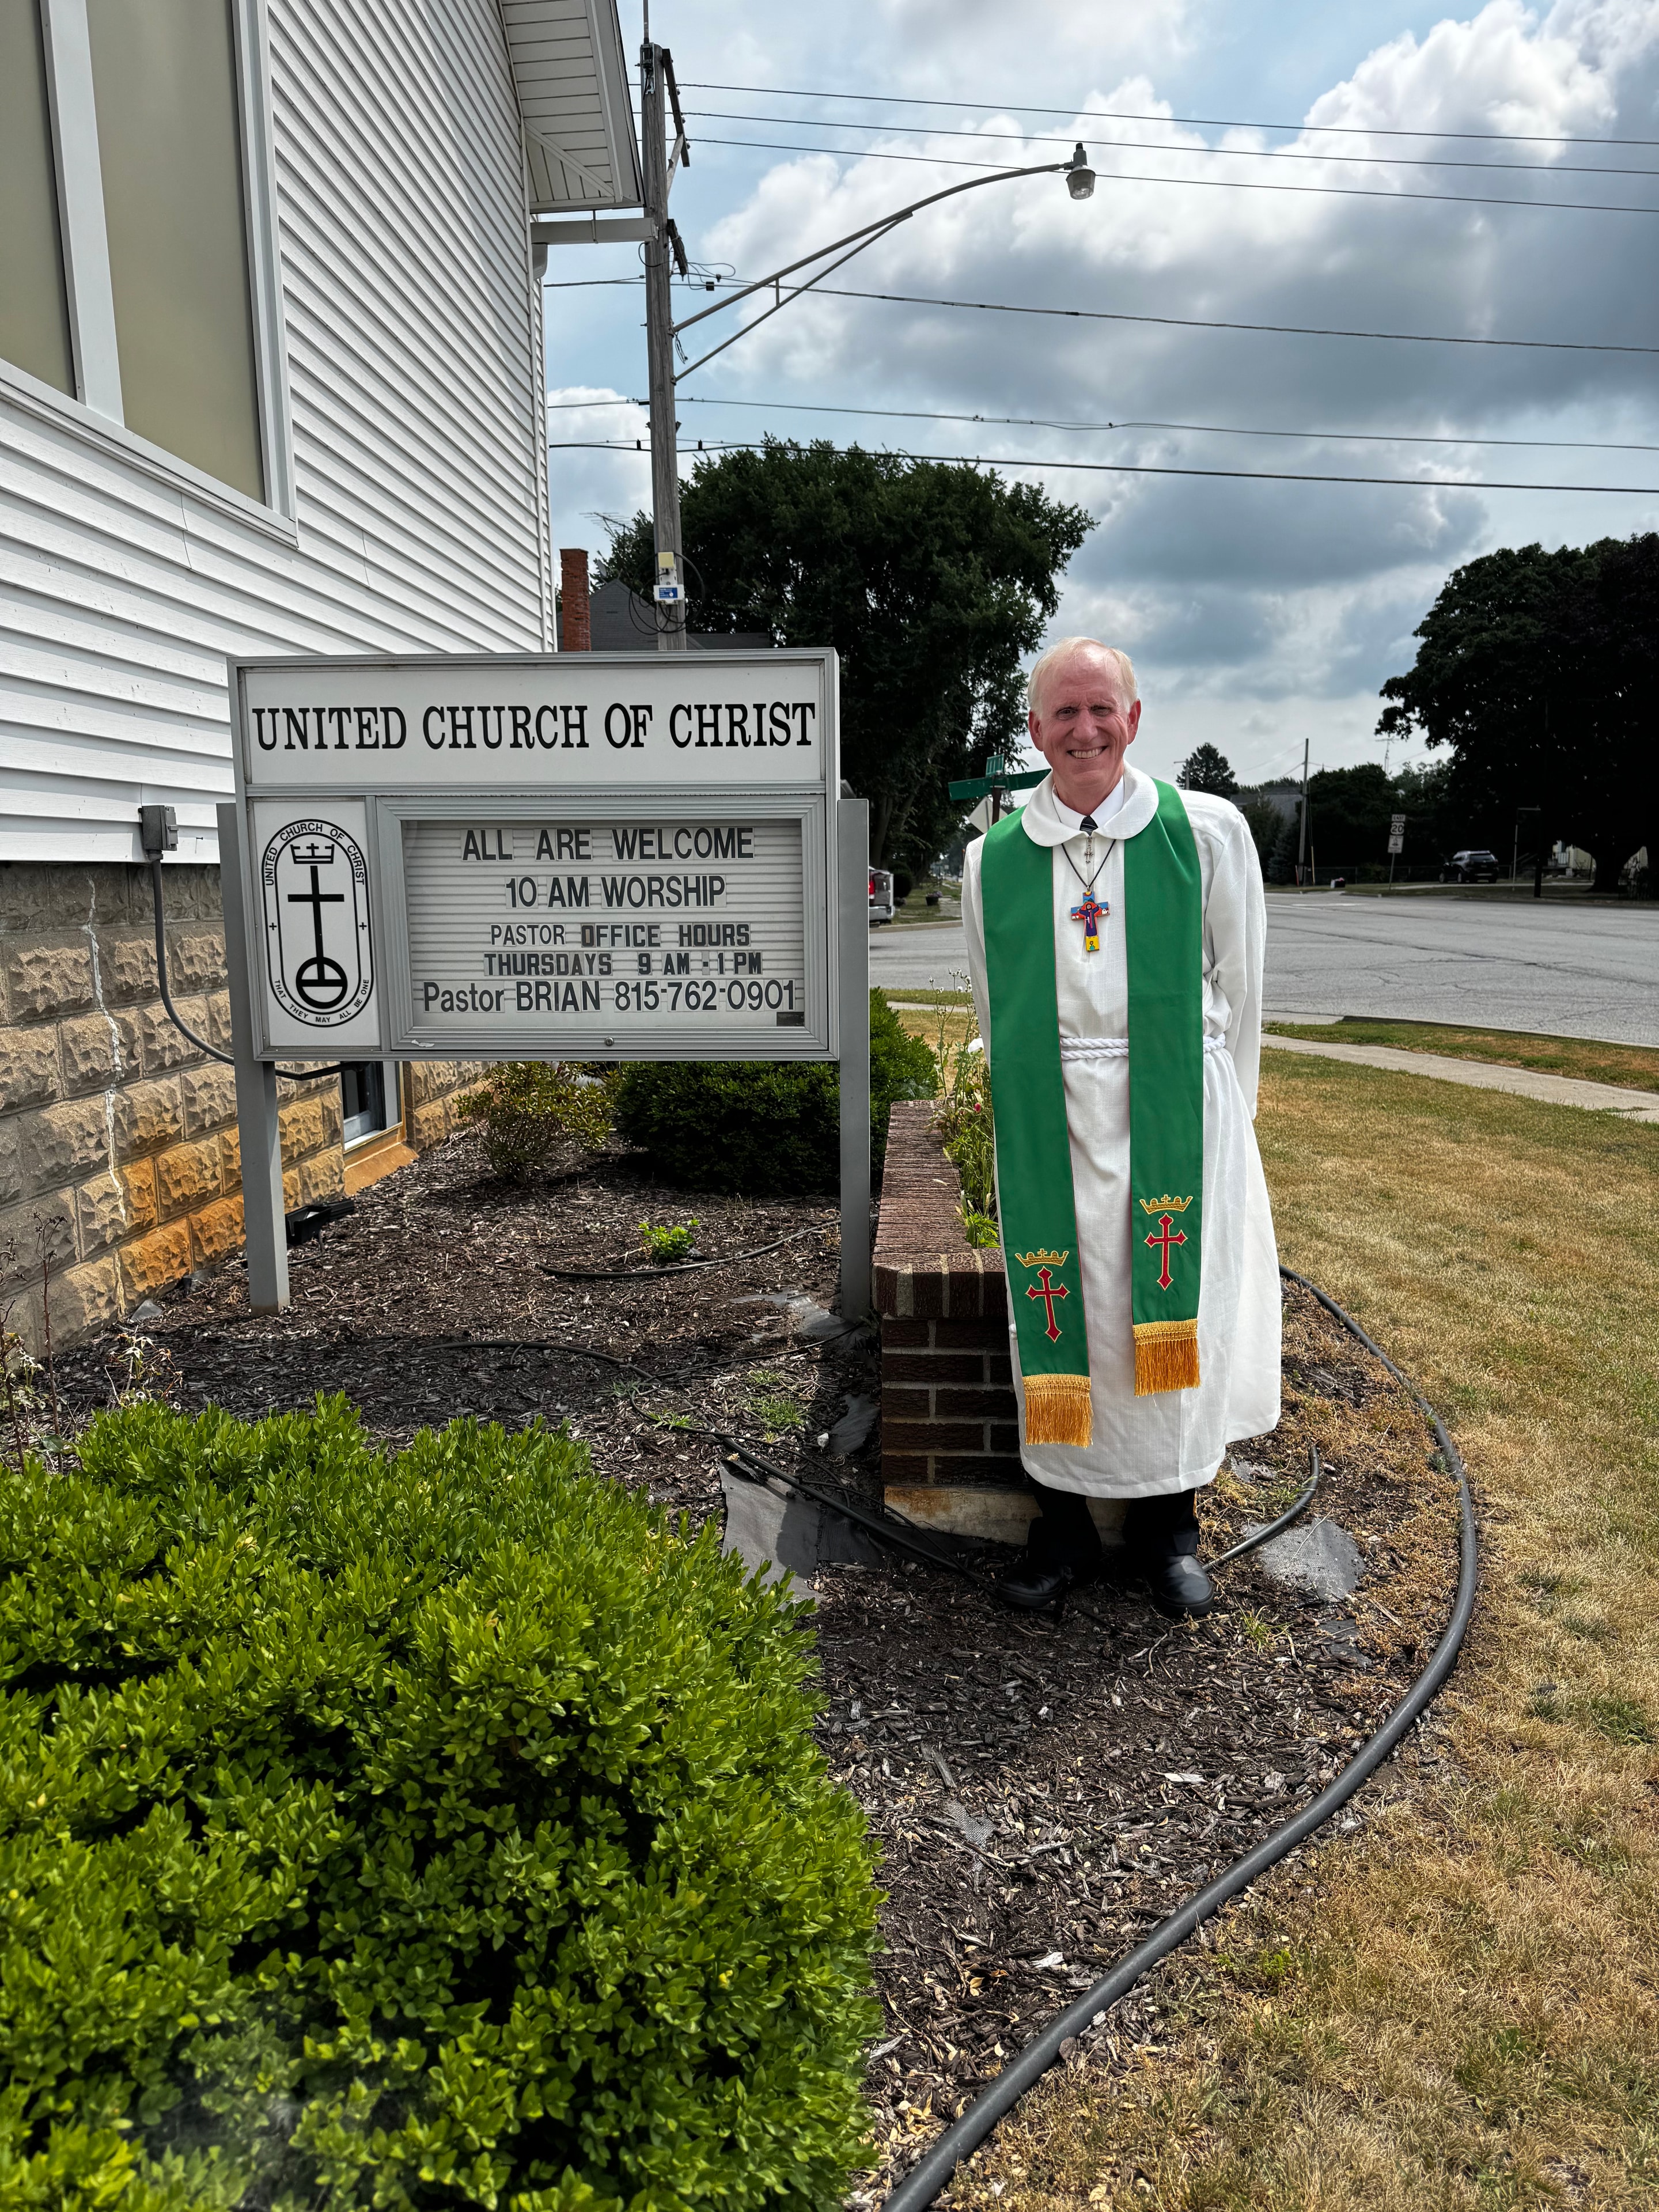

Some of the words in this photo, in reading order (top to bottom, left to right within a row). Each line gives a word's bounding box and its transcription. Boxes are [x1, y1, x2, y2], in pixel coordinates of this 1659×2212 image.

[252, 707, 407, 751] UNITED
[422, 705, 589, 750] CHURCH
[604, 703, 653, 749] OF
[669, 701, 816, 748] CHRIST
[463, 829, 513, 861] ALL
[536, 828, 592, 860] ARE
[612, 827, 754, 860] WELCOME
[1391, 824, 1403, 833] 20
[265, 846, 278, 886] UNITED
[279, 823, 323, 842] CHURCH
[329, 828, 345, 841] OF
[347, 844, 365, 885] CHRIST
[506, 877, 537, 908] 10
[548, 876, 589, 907] AM
[600, 875, 725, 908] WORSHIP
[491, 925, 565, 945] PASTOR
[581, 925, 661, 947] OFFICE
[679, 924, 749, 947] HOURS
[484, 953, 612, 976] THURSDAYS
[638, 953, 651, 975] 9
[663, 953, 690, 975] AM
[718, 952, 724, 975] 1
[734, 952, 762, 975] PM
[274, 979, 287, 999] THAT
[289, 1003, 309, 1019] THEY
[339, 1010, 352, 1020] ALL
[354, 998, 363, 1008] BE
[361, 979, 369, 995] ONE
[423, 982, 504, 1012] Pastor
[516, 980, 600, 1012] BRIAN
[615, 979, 794, 1011] 815-762-0901
